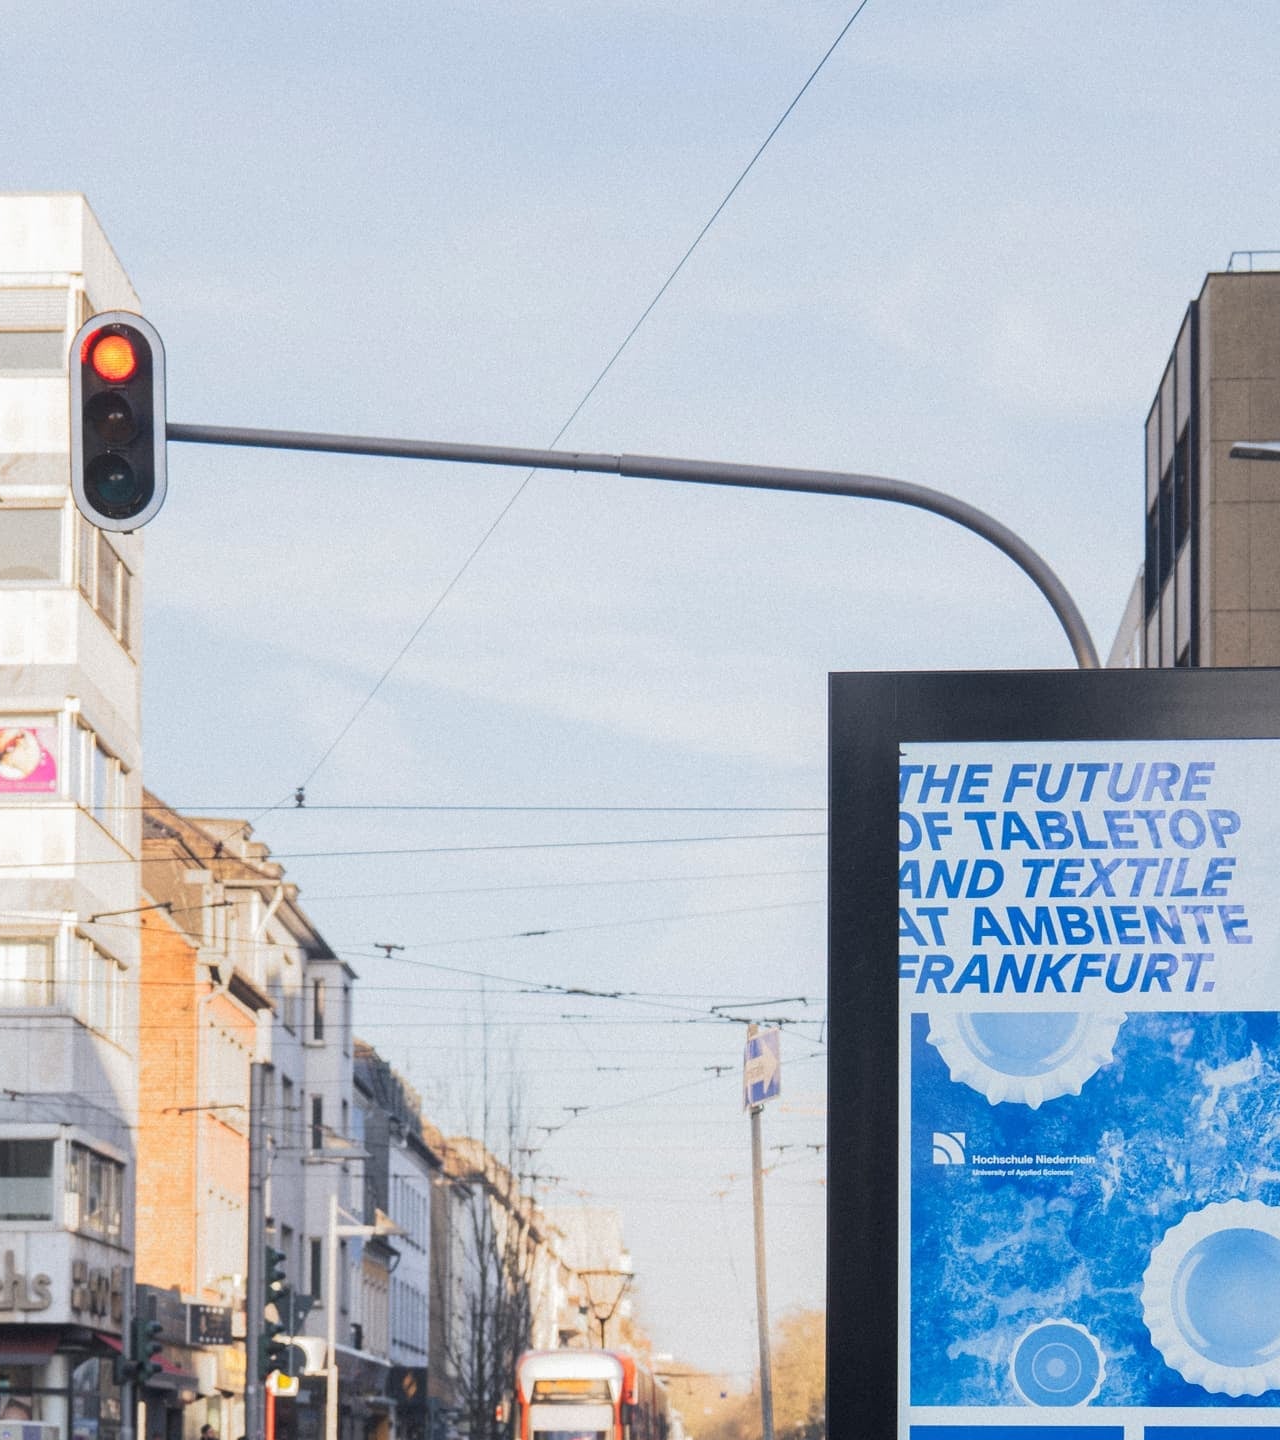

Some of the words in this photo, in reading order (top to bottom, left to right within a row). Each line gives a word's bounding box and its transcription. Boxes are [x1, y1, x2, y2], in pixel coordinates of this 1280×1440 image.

[899, 764, 993, 804] THE
[1002, 762, 1216, 803] FUTURE
[899, 811, 953, 852] OF
[964, 809, 1241, 851] TABLETOP
[899, 859, 1005, 899] AND
[1022, 857, 1237, 898] TEXTILE
[972, 905, 1253, 946] AMBIENTE
[972, 1154, 1033, 1165] Hochschule
[1036, 1154, 1096, 1164] Niederrhein
[972, 1169, 1006, 1177] University
[1015, 1169, 1041, 1177] Applied
